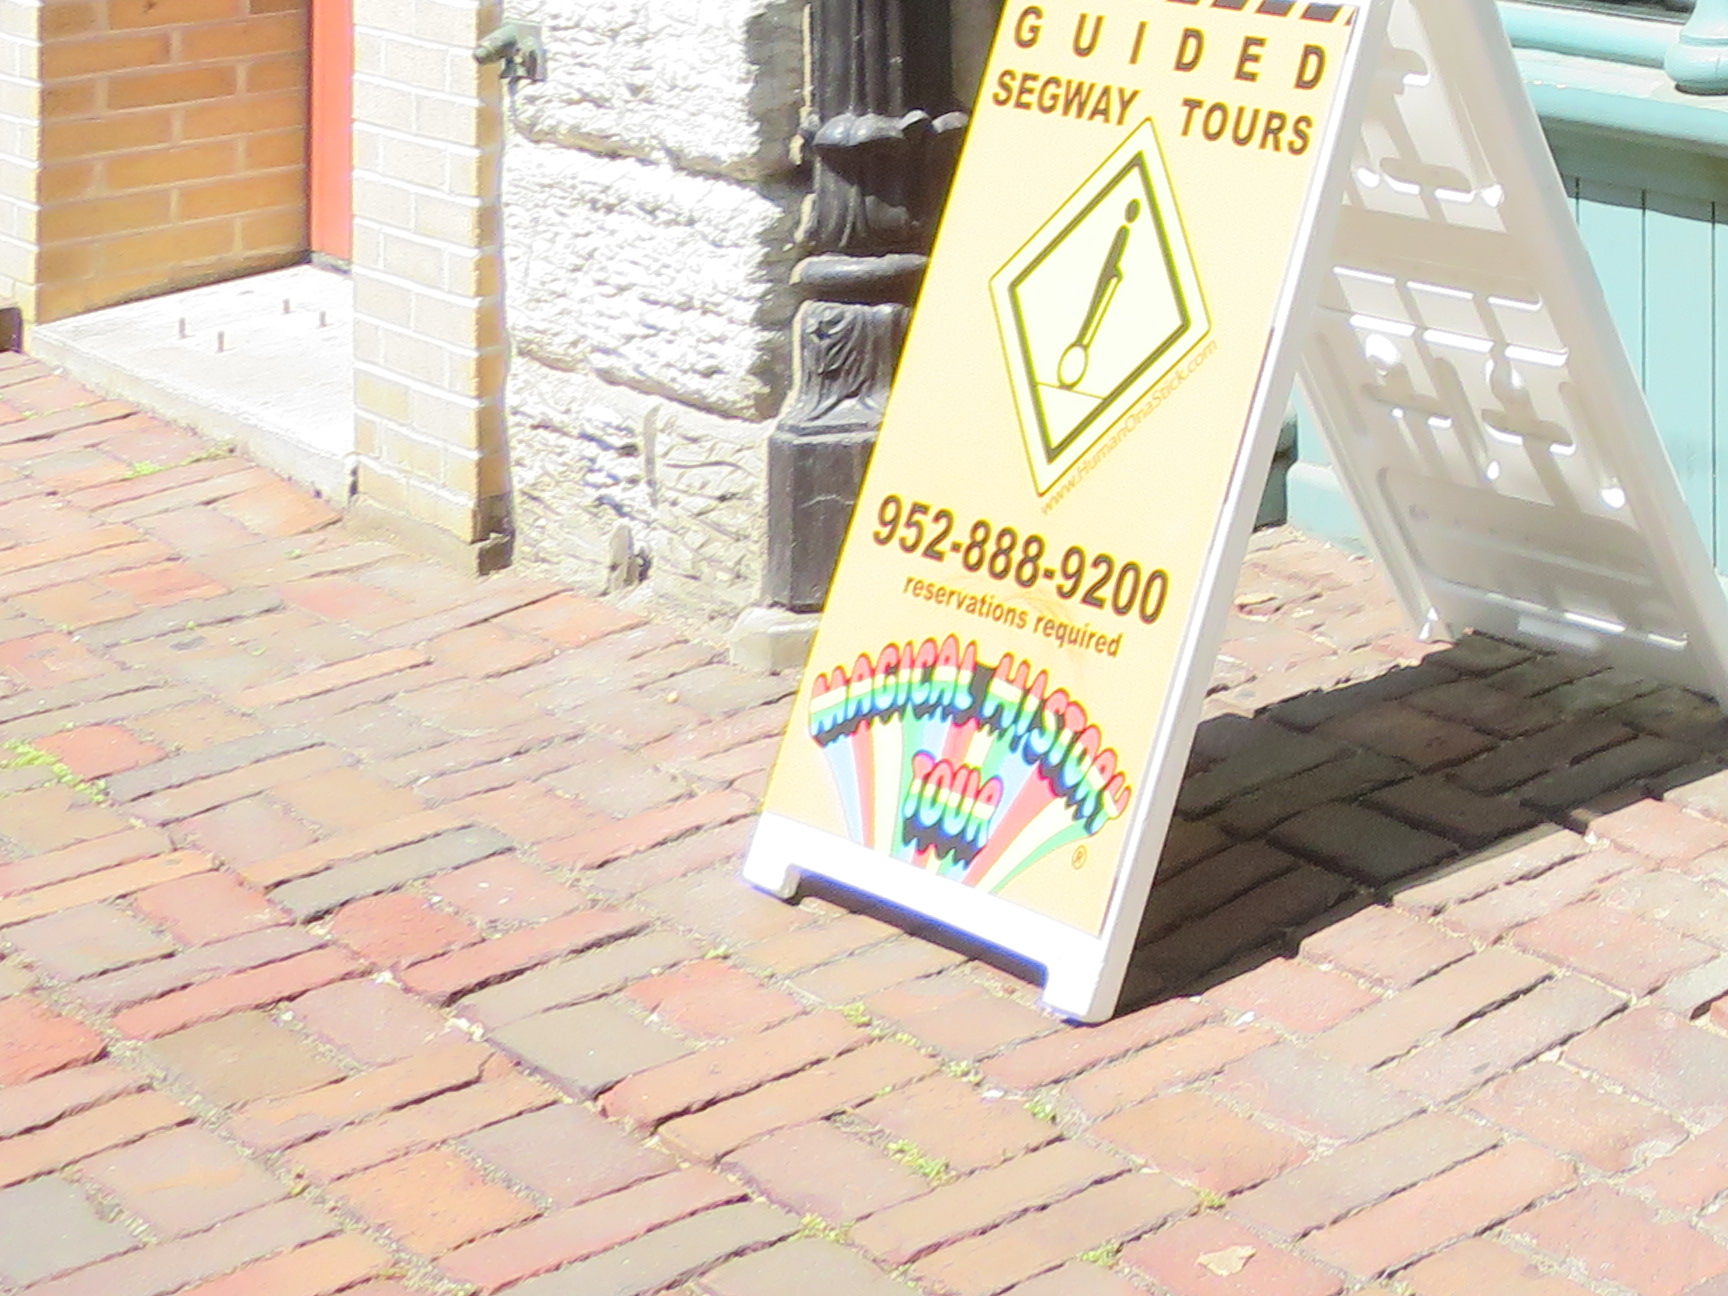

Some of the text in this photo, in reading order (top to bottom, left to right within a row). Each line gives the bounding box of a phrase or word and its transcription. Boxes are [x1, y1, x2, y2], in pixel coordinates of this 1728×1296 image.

[1013, 5, 1327, 90] GUIDED
[992, 68, 1313, 156] SEGWAY TOURS
[872, 493, 1170, 625] 952-888-9200
[902, 575, 1124, 658] reservations required
[809, 633, 1132, 836] MAGICAL HISTORY
[902, 749, 1005, 855] TOUR
